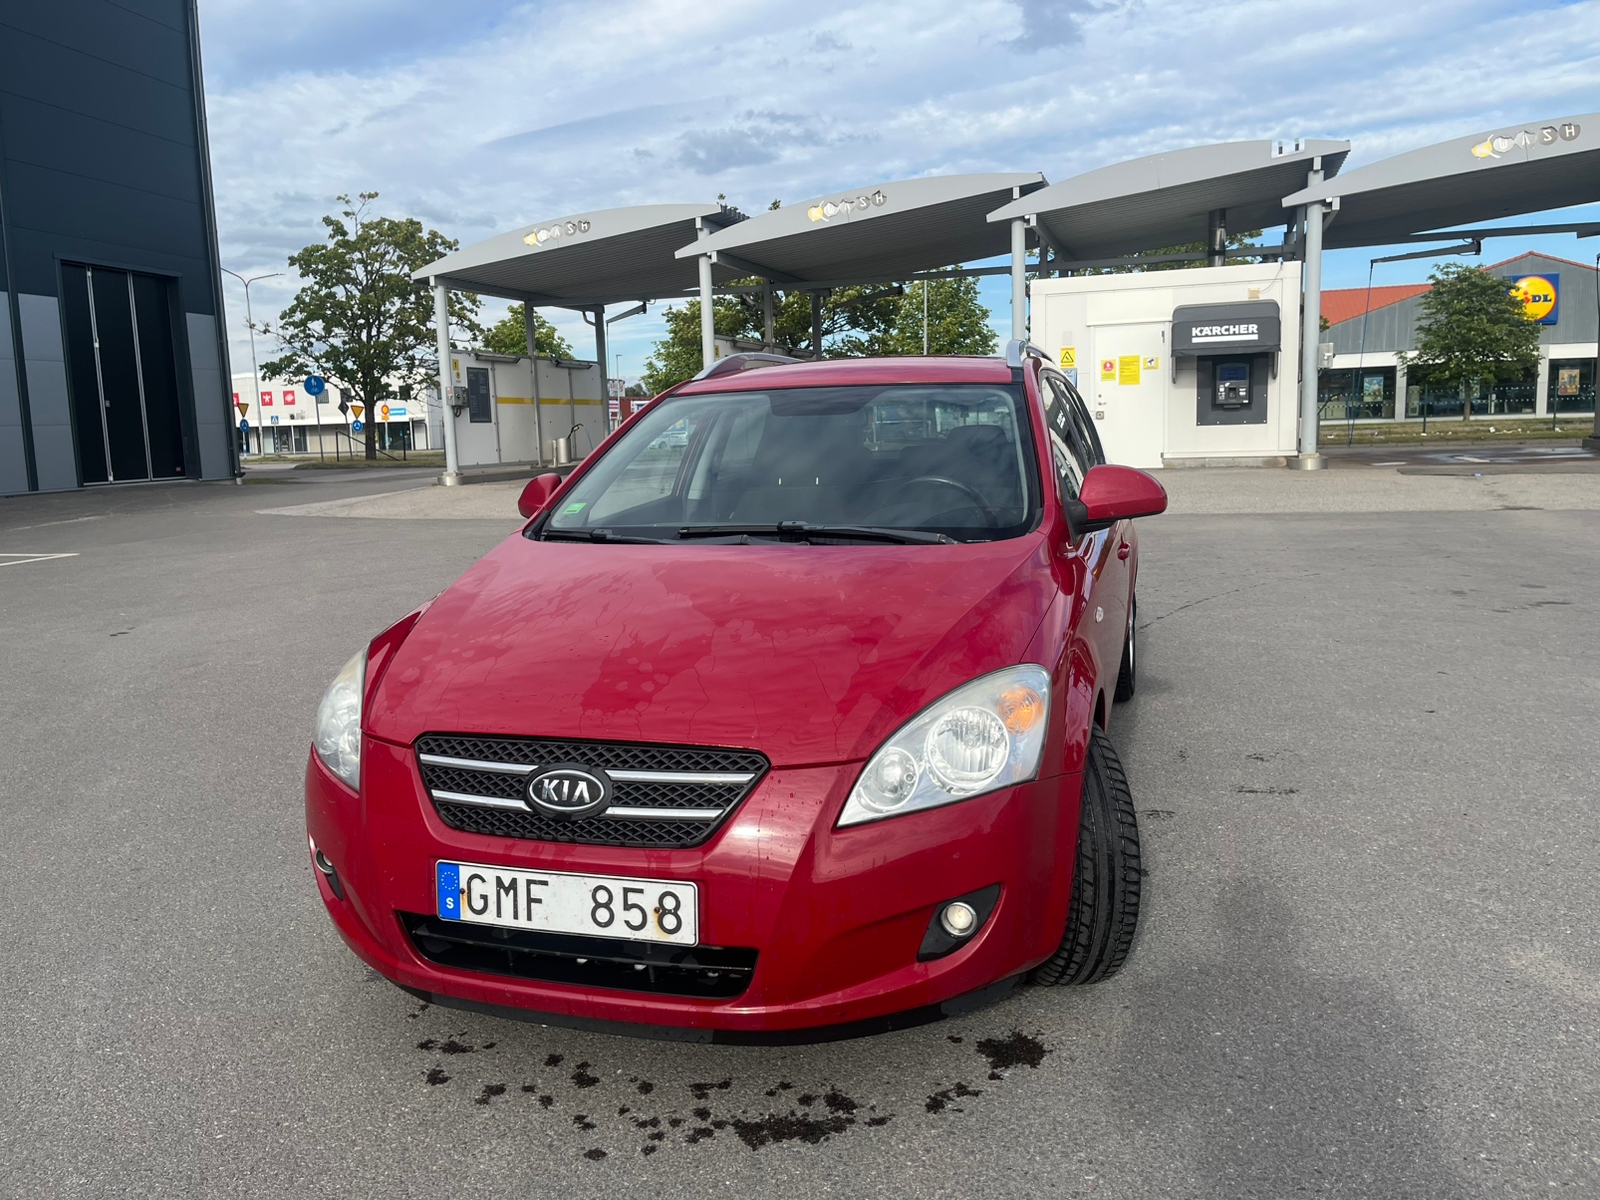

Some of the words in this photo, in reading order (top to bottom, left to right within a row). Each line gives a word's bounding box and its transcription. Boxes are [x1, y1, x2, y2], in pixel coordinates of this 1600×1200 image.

[1191, 323, 1259, 337] KÄRCHER
[541, 778, 591, 803] KIA
[445, 896, 454, 910] S
[466, 873, 549, 922] GMF
[591, 884, 682, 935] 858
